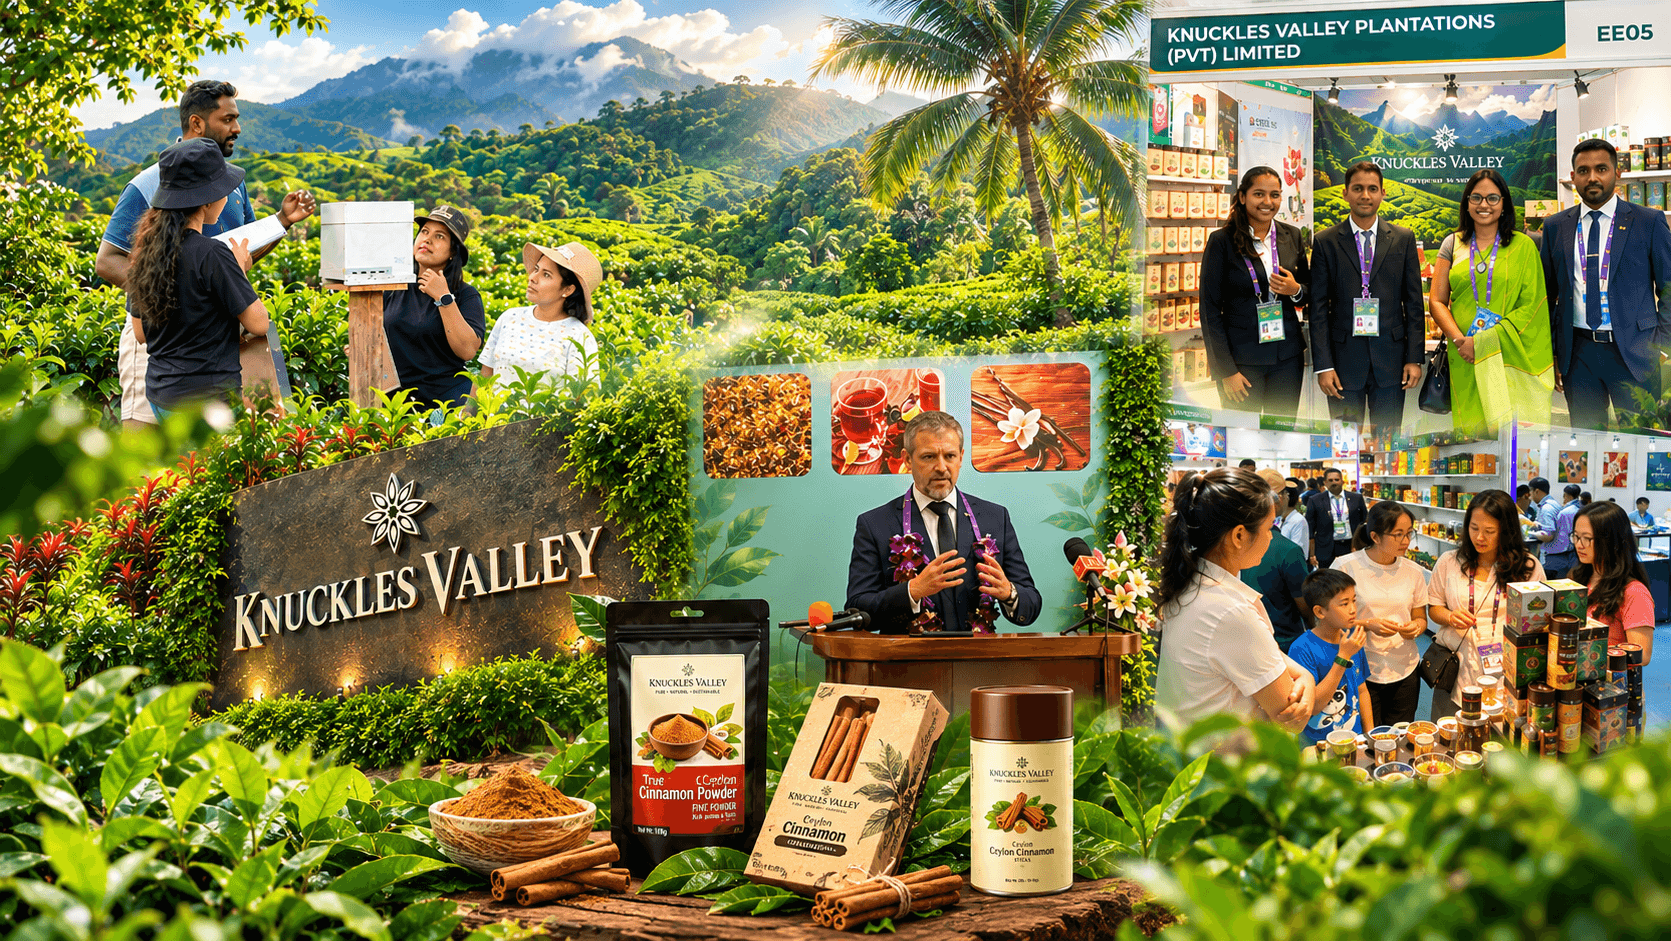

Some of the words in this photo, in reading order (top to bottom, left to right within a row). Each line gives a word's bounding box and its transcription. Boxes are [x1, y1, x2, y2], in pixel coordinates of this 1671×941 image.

[1167, 24, 1270, 43] KNUCKLES
[1275, 20, 1350, 38] VALLEY
[1355, 13, 1496, 34] PLANTATIONS
[1597, 24, 1654, 42] EE05
[1167, 47, 1217, 66] (PVT)
[1222, 44, 1301, 61] LIMITED
[1371, 157, 1447, 169] KNUCKLES
[1449, 155, 1505, 168] VALLEY
[233, 566, 418, 651] KNUCKLES
[421, 526, 602, 616] VALLEY
[649, 679, 694, 687] KNUCKLES
[695, 678, 727, 687] VALLEY
[642, 774, 664, 786] True
[989, 769, 1026, 778] KNUCKLES
[1028, 769, 1054, 777] VALLEY
[639, 785, 694, 800] Cinnamon
[697, 785, 738, 800] Powder
[829, 797, 860, 809] VALLEY
[782, 821, 847, 843] Cinnamon
[1016, 848, 1054, 856] Cinnamon
